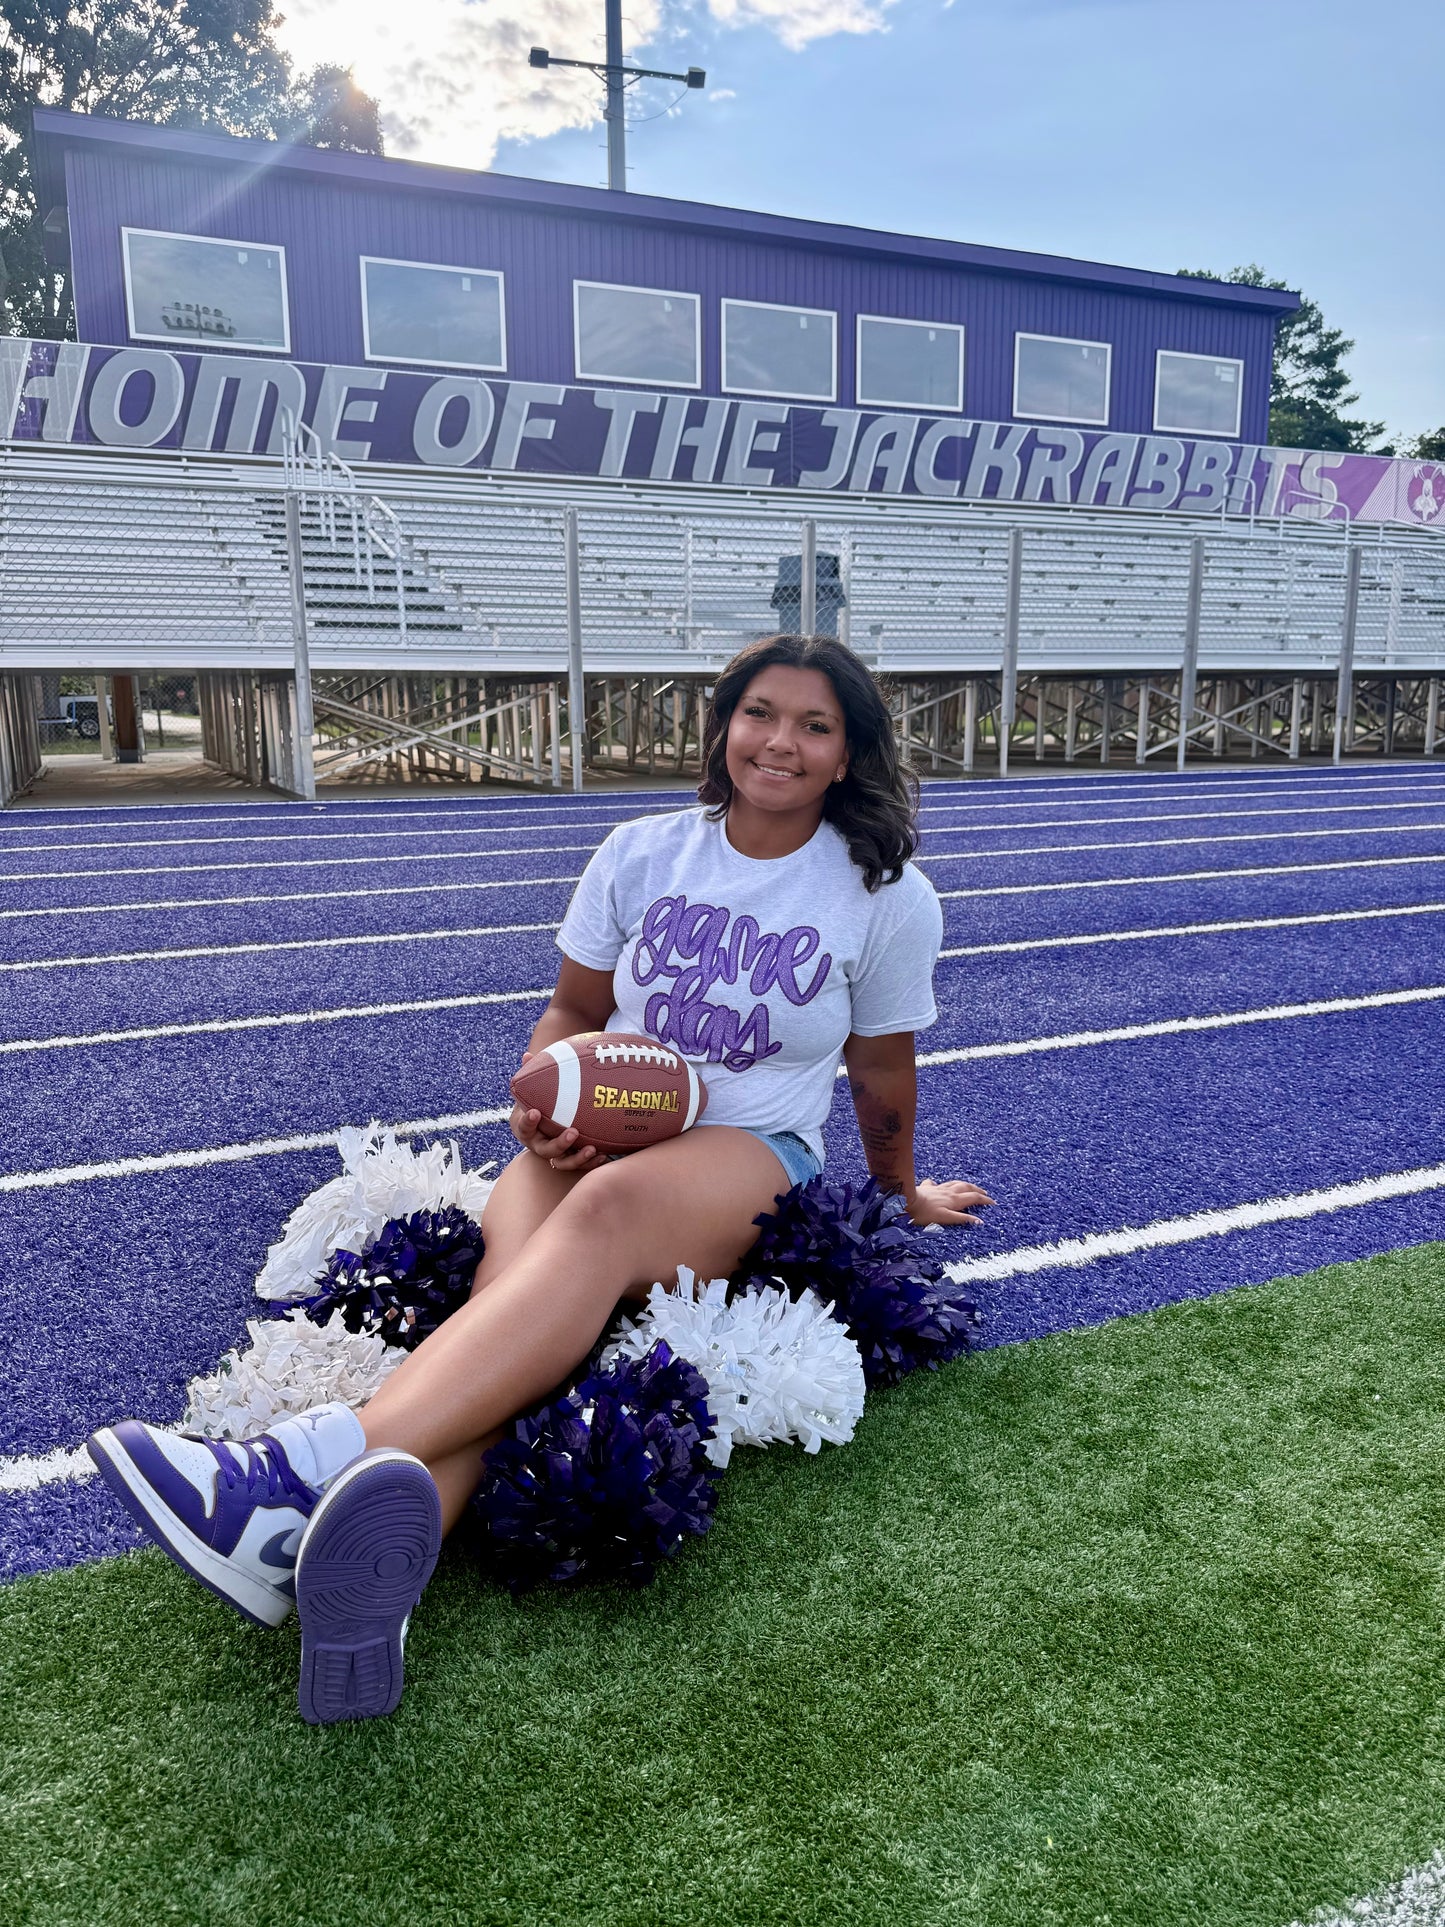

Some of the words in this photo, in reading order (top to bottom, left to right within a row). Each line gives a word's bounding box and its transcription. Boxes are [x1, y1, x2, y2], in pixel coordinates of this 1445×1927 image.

[0, 341, 388, 461] HOME
[413, 376, 566, 470] OF
[594, 390, 790, 486] THE
[798, 410, 1345, 518] JACKRABBITS
[631, 895, 831, 1006] game
[645, 965, 782, 1073] day
[593, 1084, 680, 1113] SEASONAL
